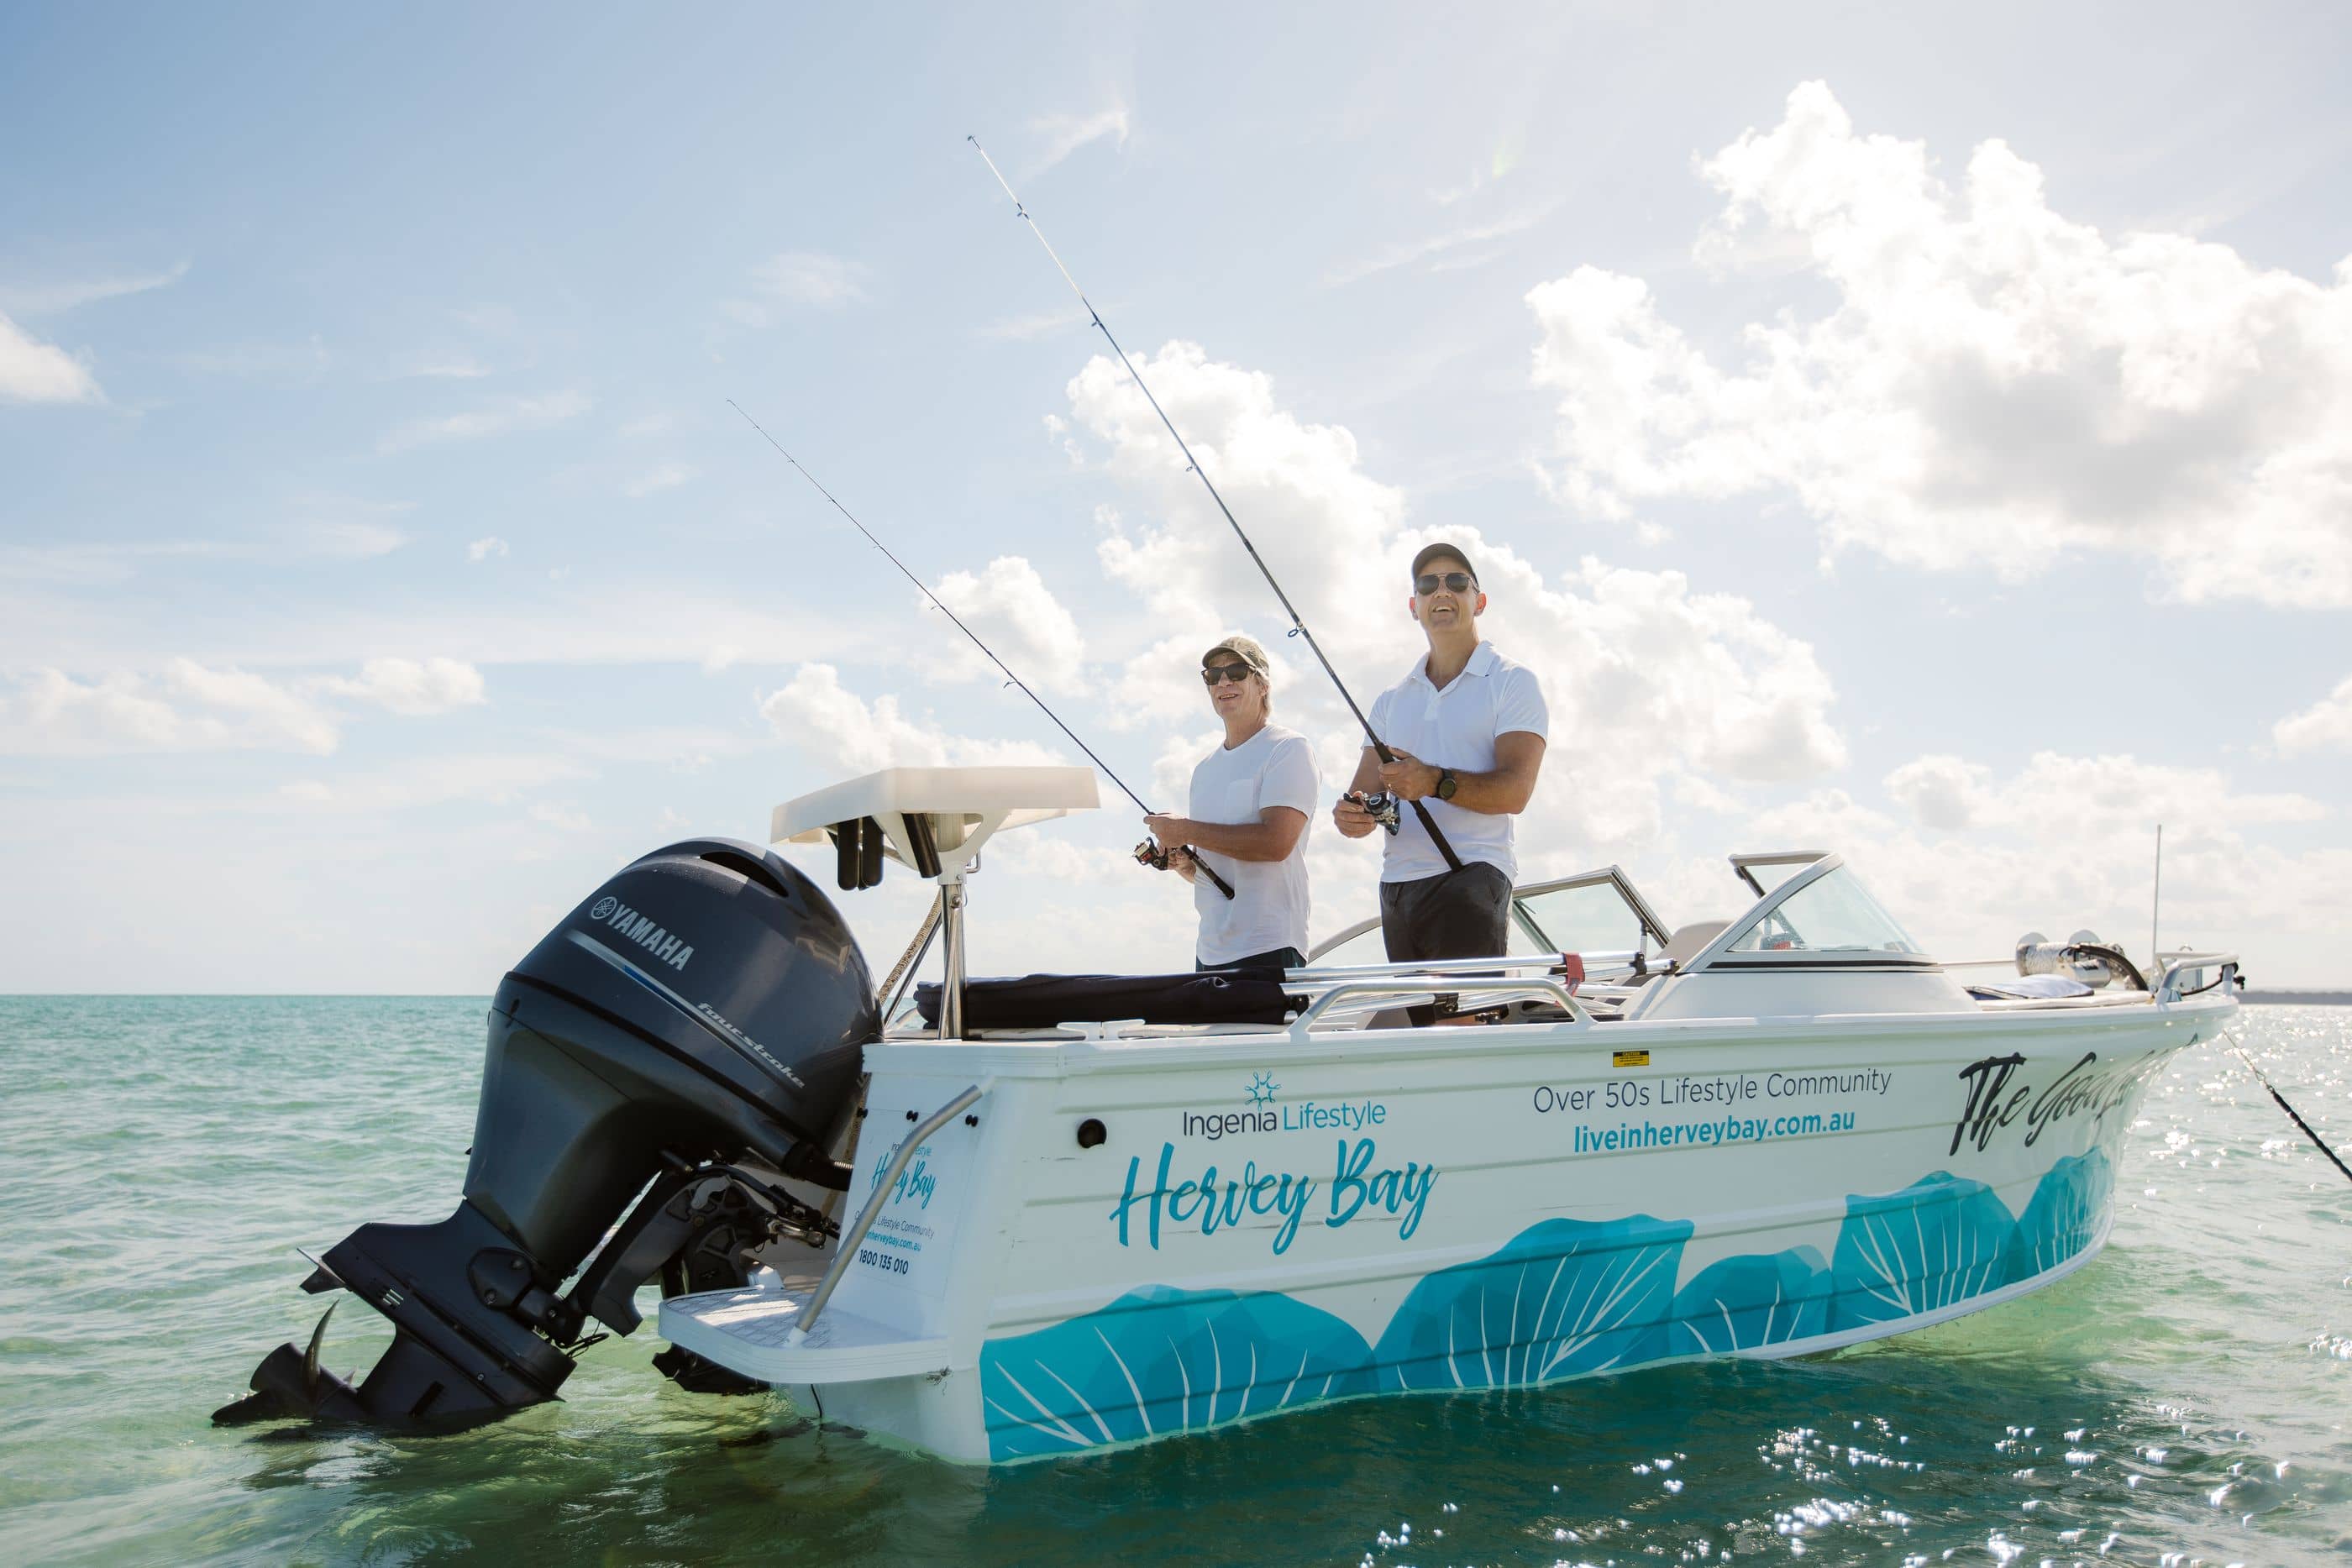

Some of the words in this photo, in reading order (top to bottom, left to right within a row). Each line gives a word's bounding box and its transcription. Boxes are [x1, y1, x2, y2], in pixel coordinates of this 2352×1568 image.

[607, 904, 694, 971] YAMAHA
[1534, 1086, 1595, 1113] Over
[1605, 1081, 1650, 1108] 50s
[1660, 1074, 1757, 1105] Lifestyle
[1767, 1067, 1893, 1098] Community
[1949, 1051, 2029, 1156] The
[1183, 1109, 1277, 1141] Ingenia
[1284, 1100, 1386, 1131] Lifestyle
[1573, 1111, 1856, 1152] liveinherveybay.com.au
[908, 1160, 936, 1209] Bay
[1109, 1141, 1317, 1256] Hervey
[1325, 1138, 1441, 1241] Bay
[877, 1215, 900, 1230] Lifestyle
[900, 1220, 934, 1240] Community
[859, 1249, 878, 1266] 1800
[879, 1254, 892, 1270] 135
[894, 1258, 909, 1274] 010
